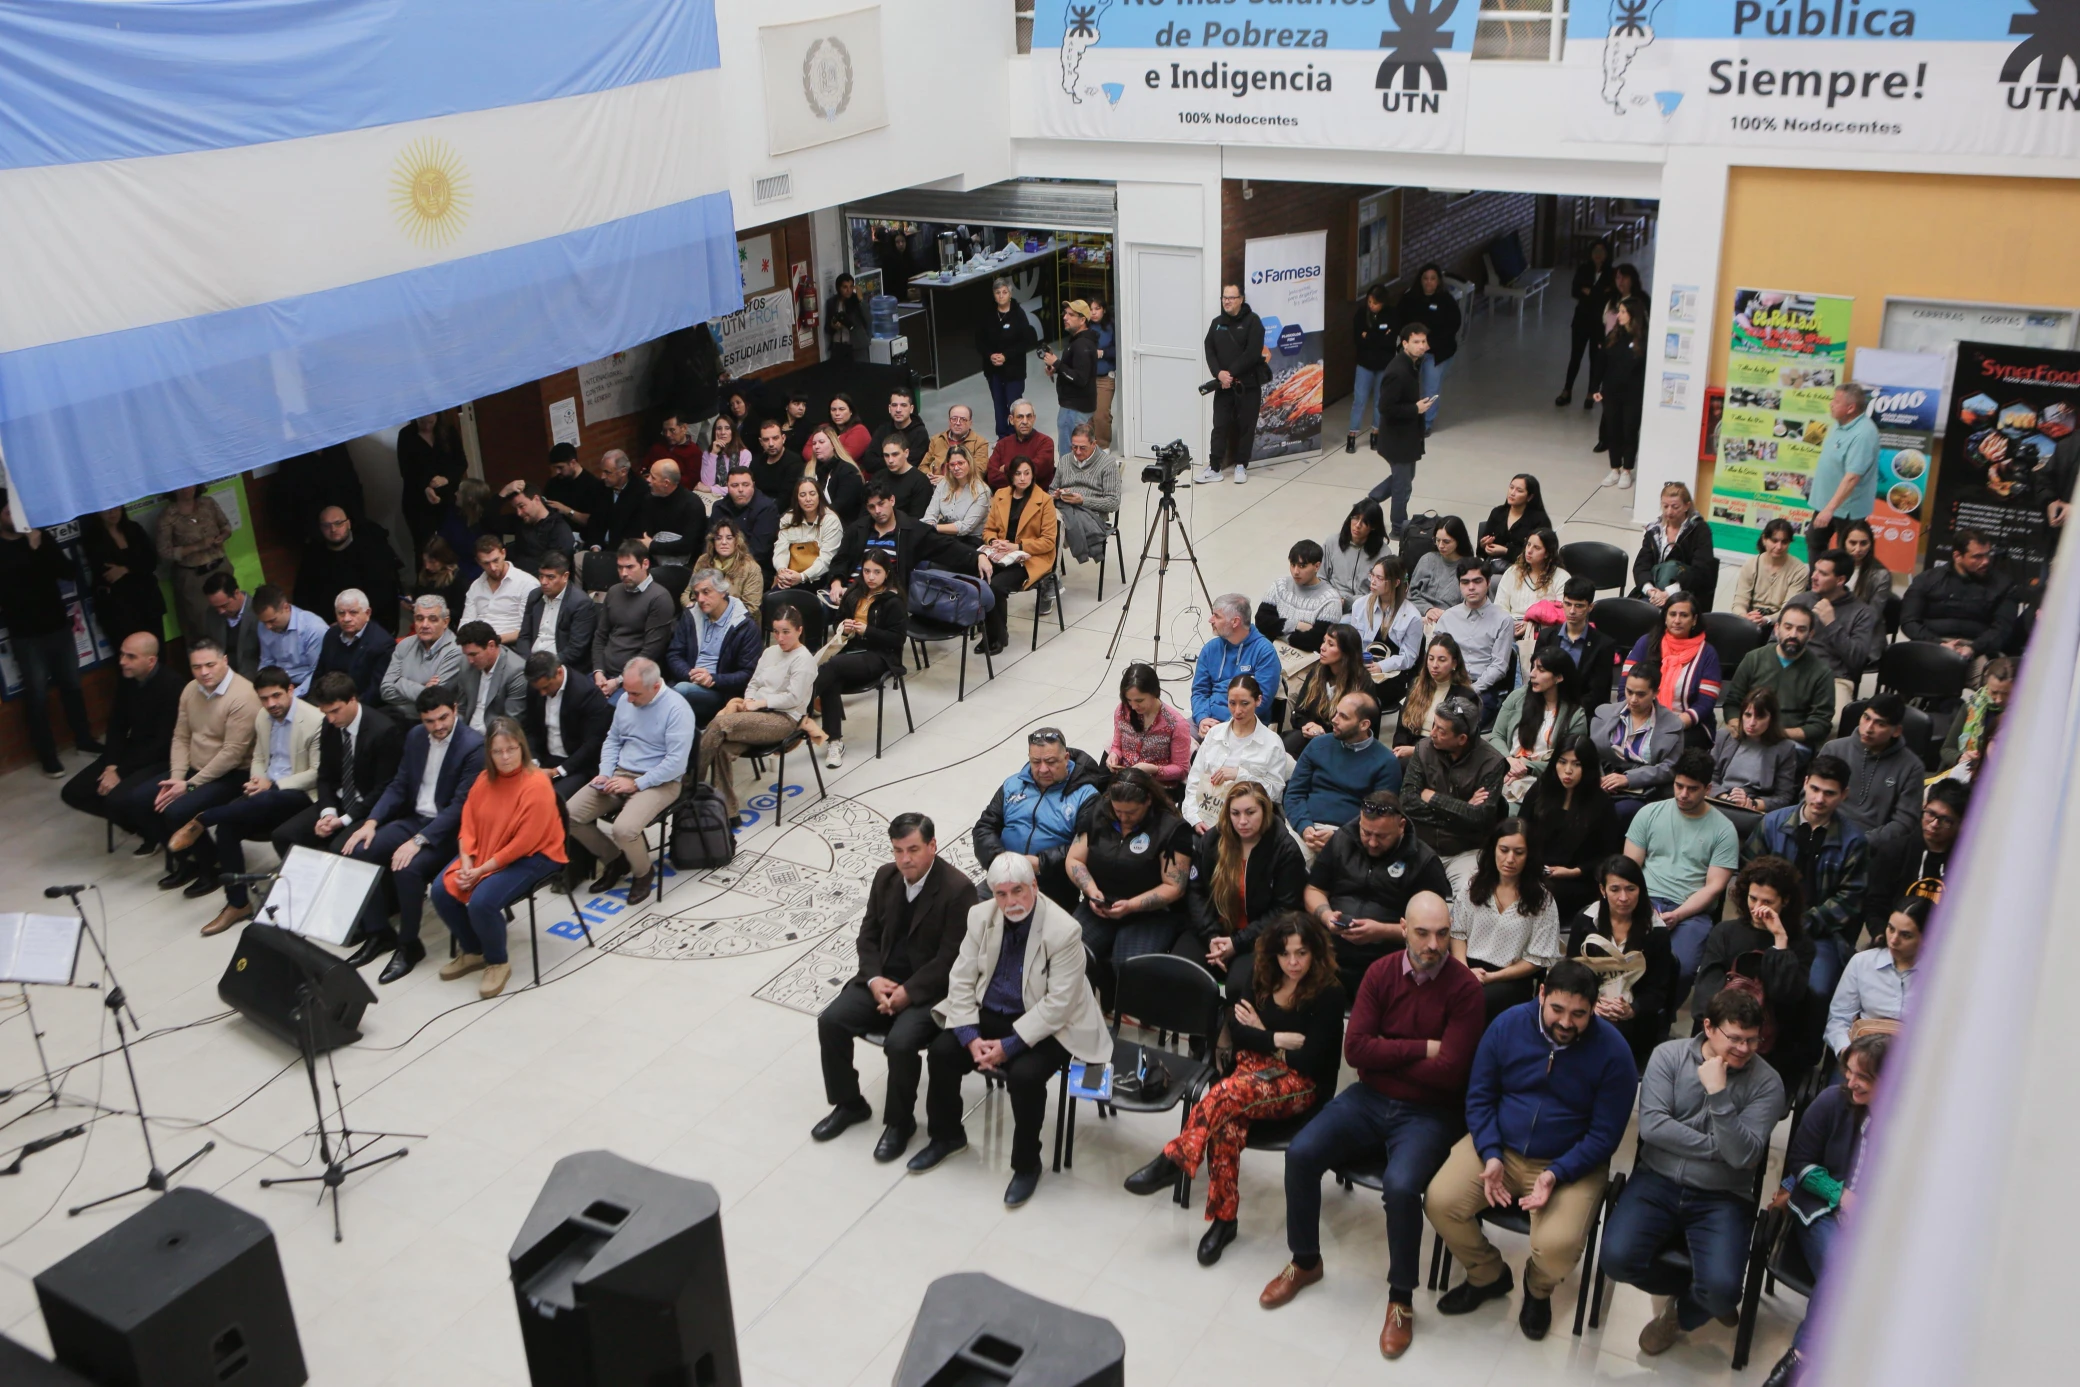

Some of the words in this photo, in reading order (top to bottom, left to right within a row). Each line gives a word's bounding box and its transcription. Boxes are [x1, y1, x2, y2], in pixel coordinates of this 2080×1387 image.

[1734, 0, 1916, 37] Pública
[1155, 21, 1191, 47] de
[1202, 20, 1329, 48] Pobreza
[1145, 68, 1160, 89] e
[1170, 61, 1332, 98] Indigencia
[1708, 58, 1928, 109] Siempre!
[1382, 92, 1440, 114] UTN
[2007, 87, 2080, 111] UTN
[1178, 112, 1212, 125] 100%
[1215, 113, 1299, 126] Nodocentes
[1731, 116, 1777, 132] 100%
[1783, 118, 1902, 135] Nodocentes
[1265, 265, 1322, 284] Farmesa
[722, 315, 747, 337] UTN
[723, 334, 793, 368] ESTUDIANTILES
